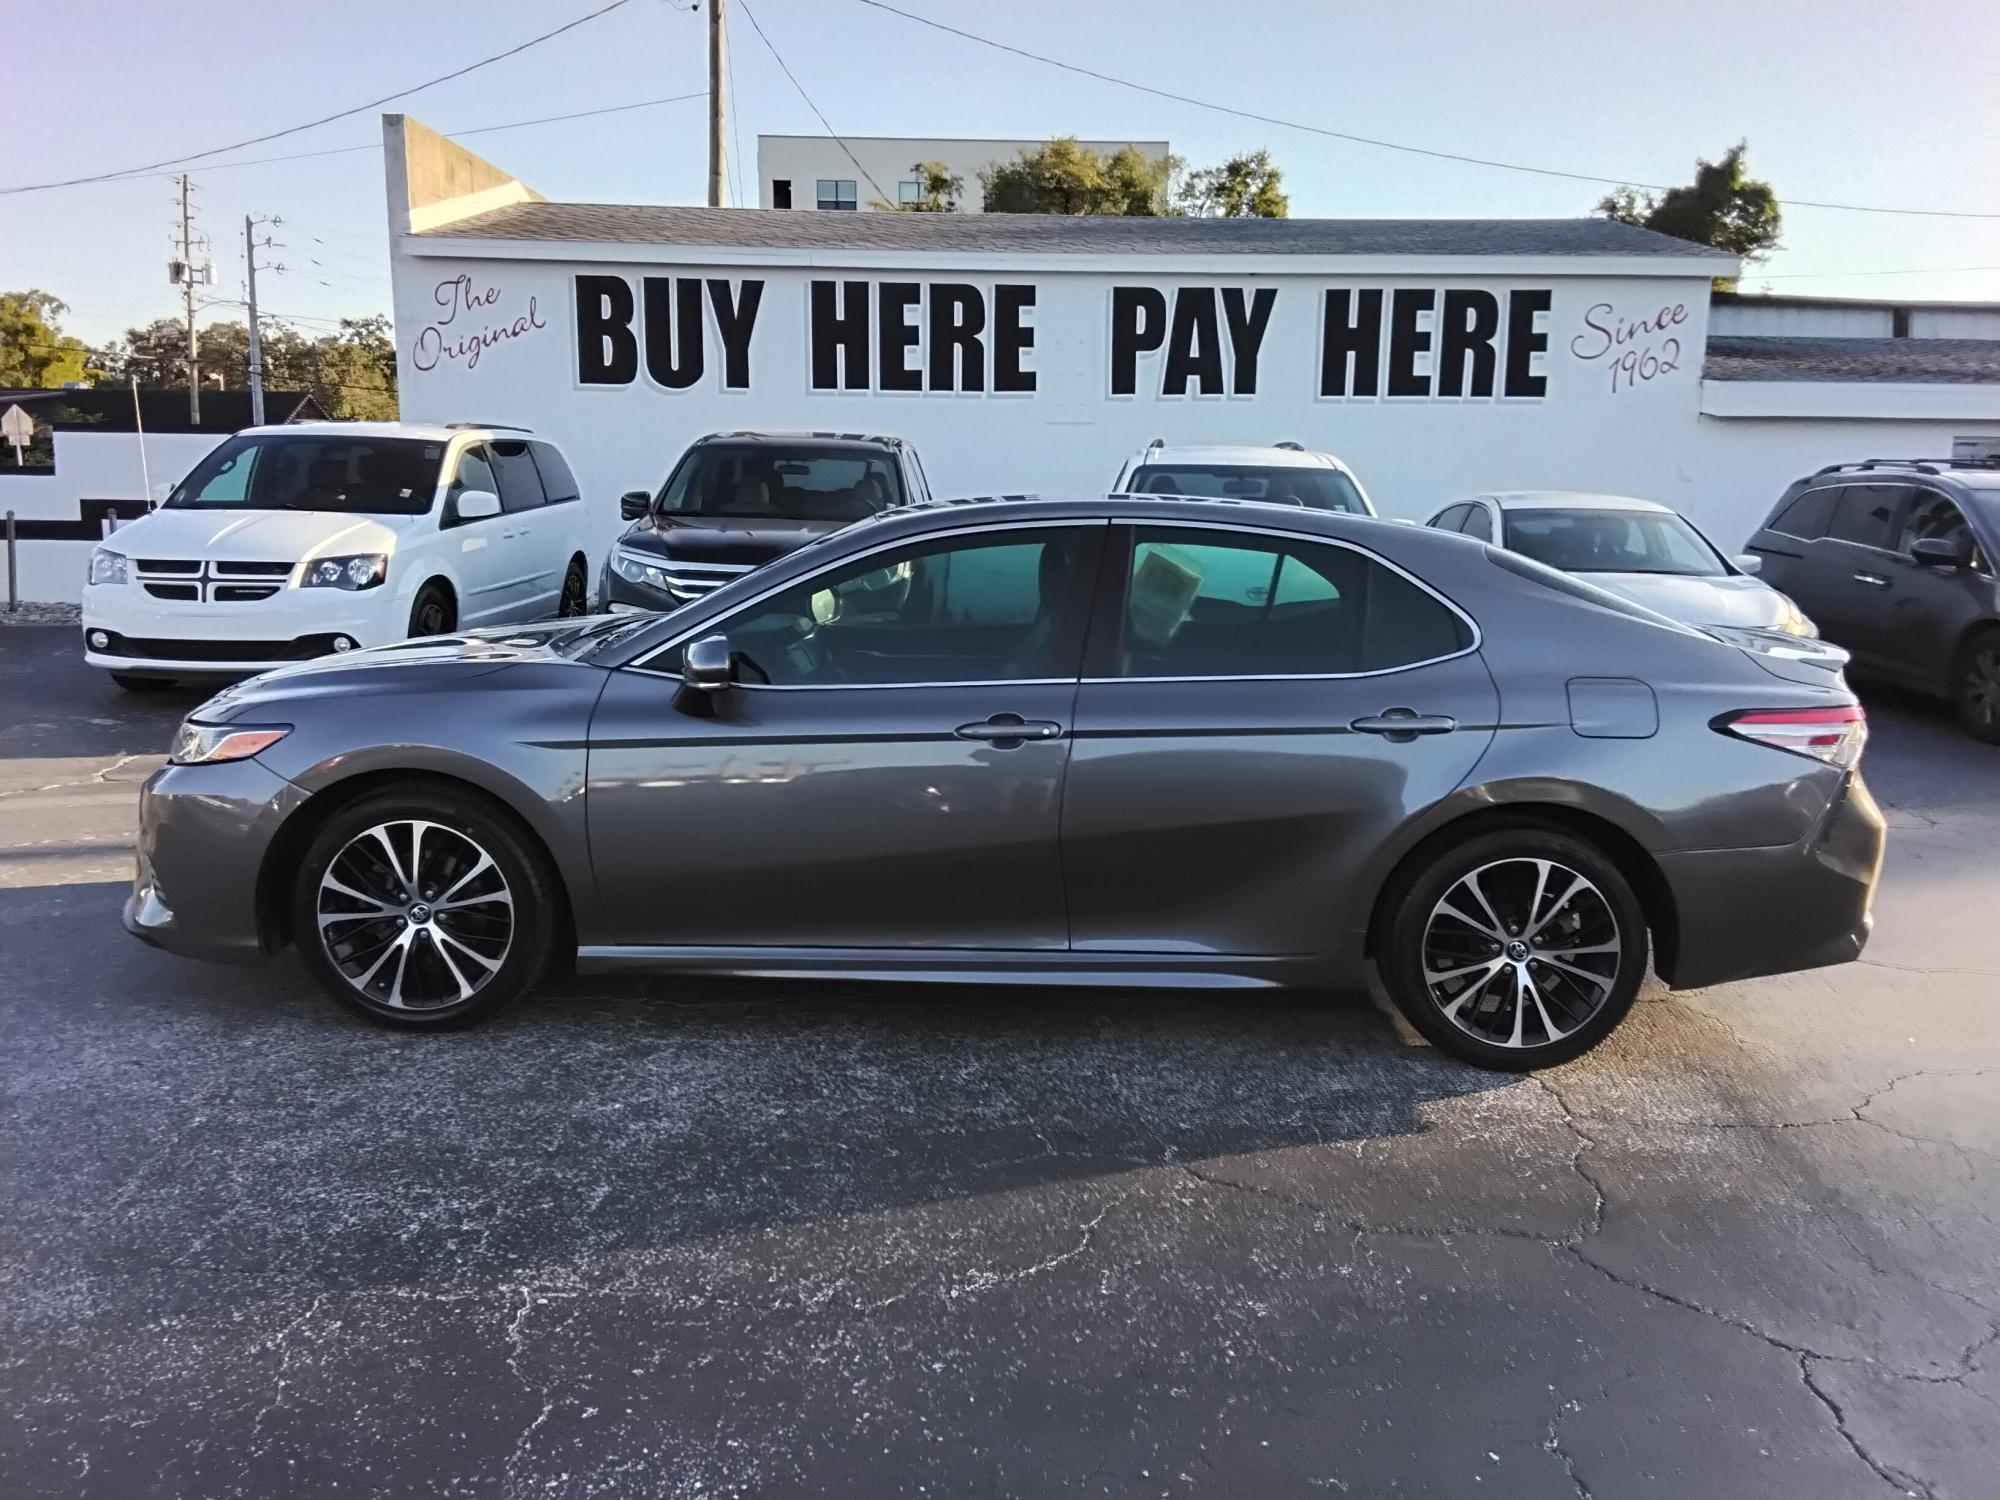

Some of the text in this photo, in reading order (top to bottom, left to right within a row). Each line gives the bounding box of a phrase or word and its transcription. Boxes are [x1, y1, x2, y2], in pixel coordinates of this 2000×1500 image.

[434, 274, 501, 324] The
[412, 296, 546, 371] Original
[575, 275, 1553, 397] BUY HERE PAY HERE
[1571, 302, 1688, 359] Since
[1608, 337, 1681, 393] 1962
